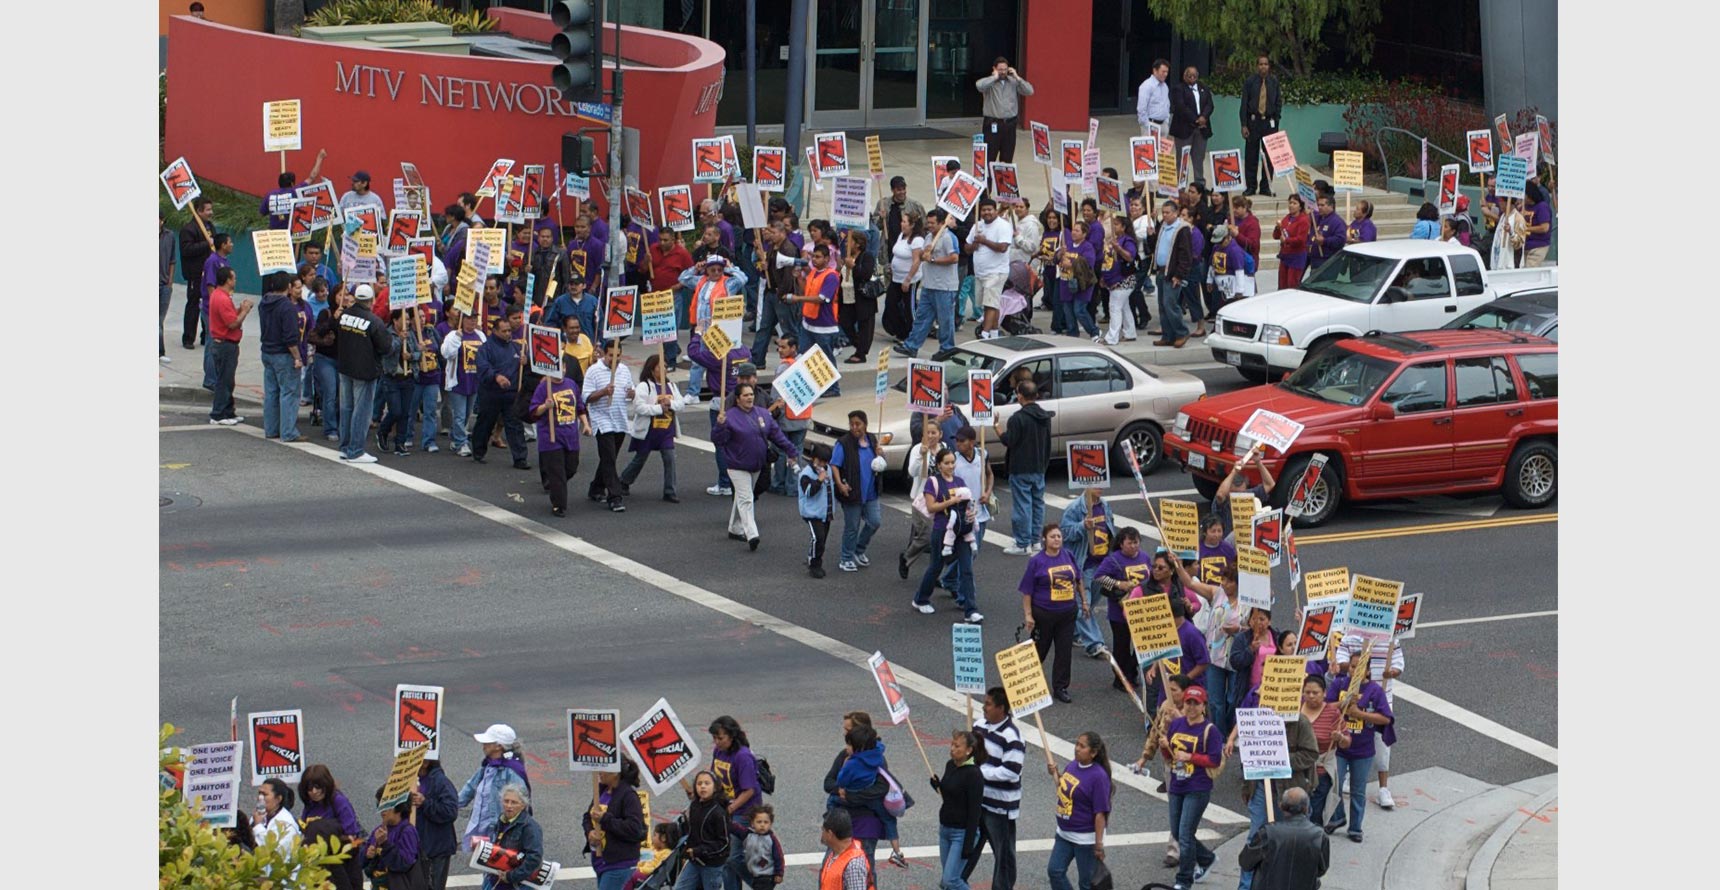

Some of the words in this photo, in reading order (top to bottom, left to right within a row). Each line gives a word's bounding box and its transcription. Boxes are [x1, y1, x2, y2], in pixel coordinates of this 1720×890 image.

[335, 62, 405, 101] MTV
[419, 74, 578, 117] NETWOR
[340, 314, 370, 330] SEIU
[1325, 587, 1348, 595] DREAM
[1375, 590, 1395, 598] VOICE
[1143, 595, 1165, 604] UNION
[1146, 604, 1166, 612] VOICE
[1353, 603, 1393, 612] JANITORS
[1146, 613, 1171, 621] DREAM
[1358, 612, 1383, 620] READY
[1134, 623, 1172, 633] JANITORS
[1362, 620, 1390, 629] STRIKE
[1142, 633, 1167, 641] READY
[1150, 640, 1177, 649] STRIKE
[998, 652, 1012, 660] ONE
[1018, 652, 1034, 662] VOICE
[1020, 661, 1039, 673] DREAM
[1008, 671, 1040, 688] JANITORS
[1016, 683, 1037, 695] READY
[1012, 700, 1022, 708] TO
[1025, 689, 1047, 703] STRIKE
[256, 716, 280, 725] JUSTICE
[283, 715, 294, 723] FOR
[633, 721, 654, 740] JUSTICE
[653, 711, 664, 723] FOR
[208, 766, 232, 774] DREAM
[261, 765, 298, 774] JANITORS
[658, 753, 690, 780] JANITORS
[191, 783, 230, 792] JANITORS
